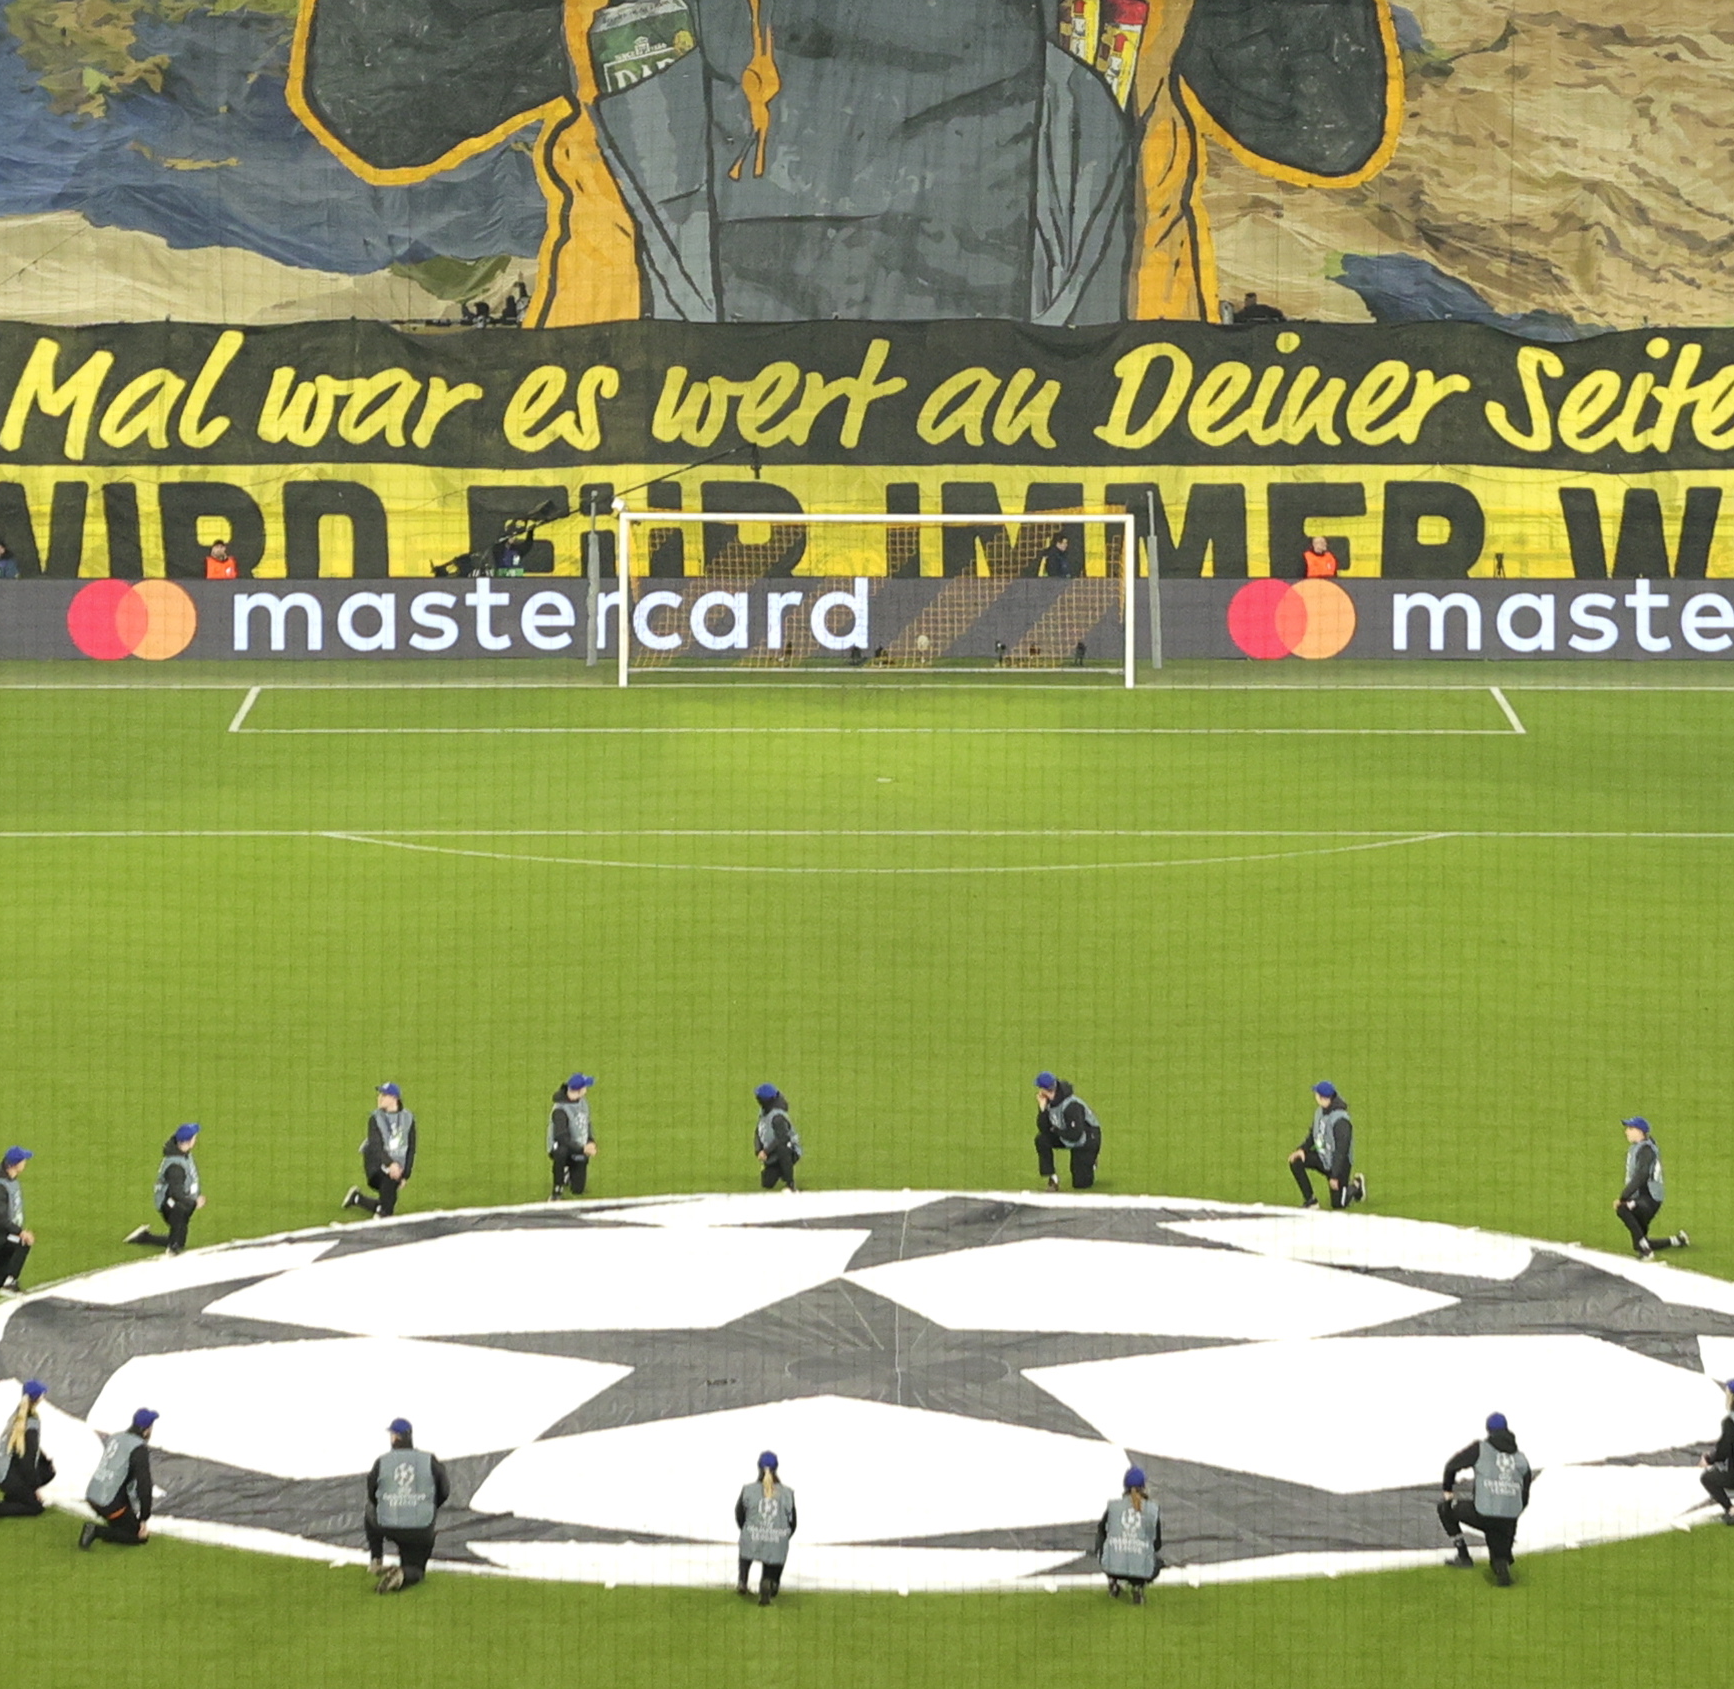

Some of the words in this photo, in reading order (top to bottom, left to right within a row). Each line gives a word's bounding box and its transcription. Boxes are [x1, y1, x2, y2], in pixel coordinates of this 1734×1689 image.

[0, 330, 245, 461] Mal
[258, 365, 483, 448] war
[503, 365, 619, 452] es
[651, 338, 907, 448] wert
[917, 367, 1061, 449] an
[1094, 332, 1470, 449] Deiner
[885, 479, 1485, 578] IMMER
[233, 576, 869, 652] mastercard
